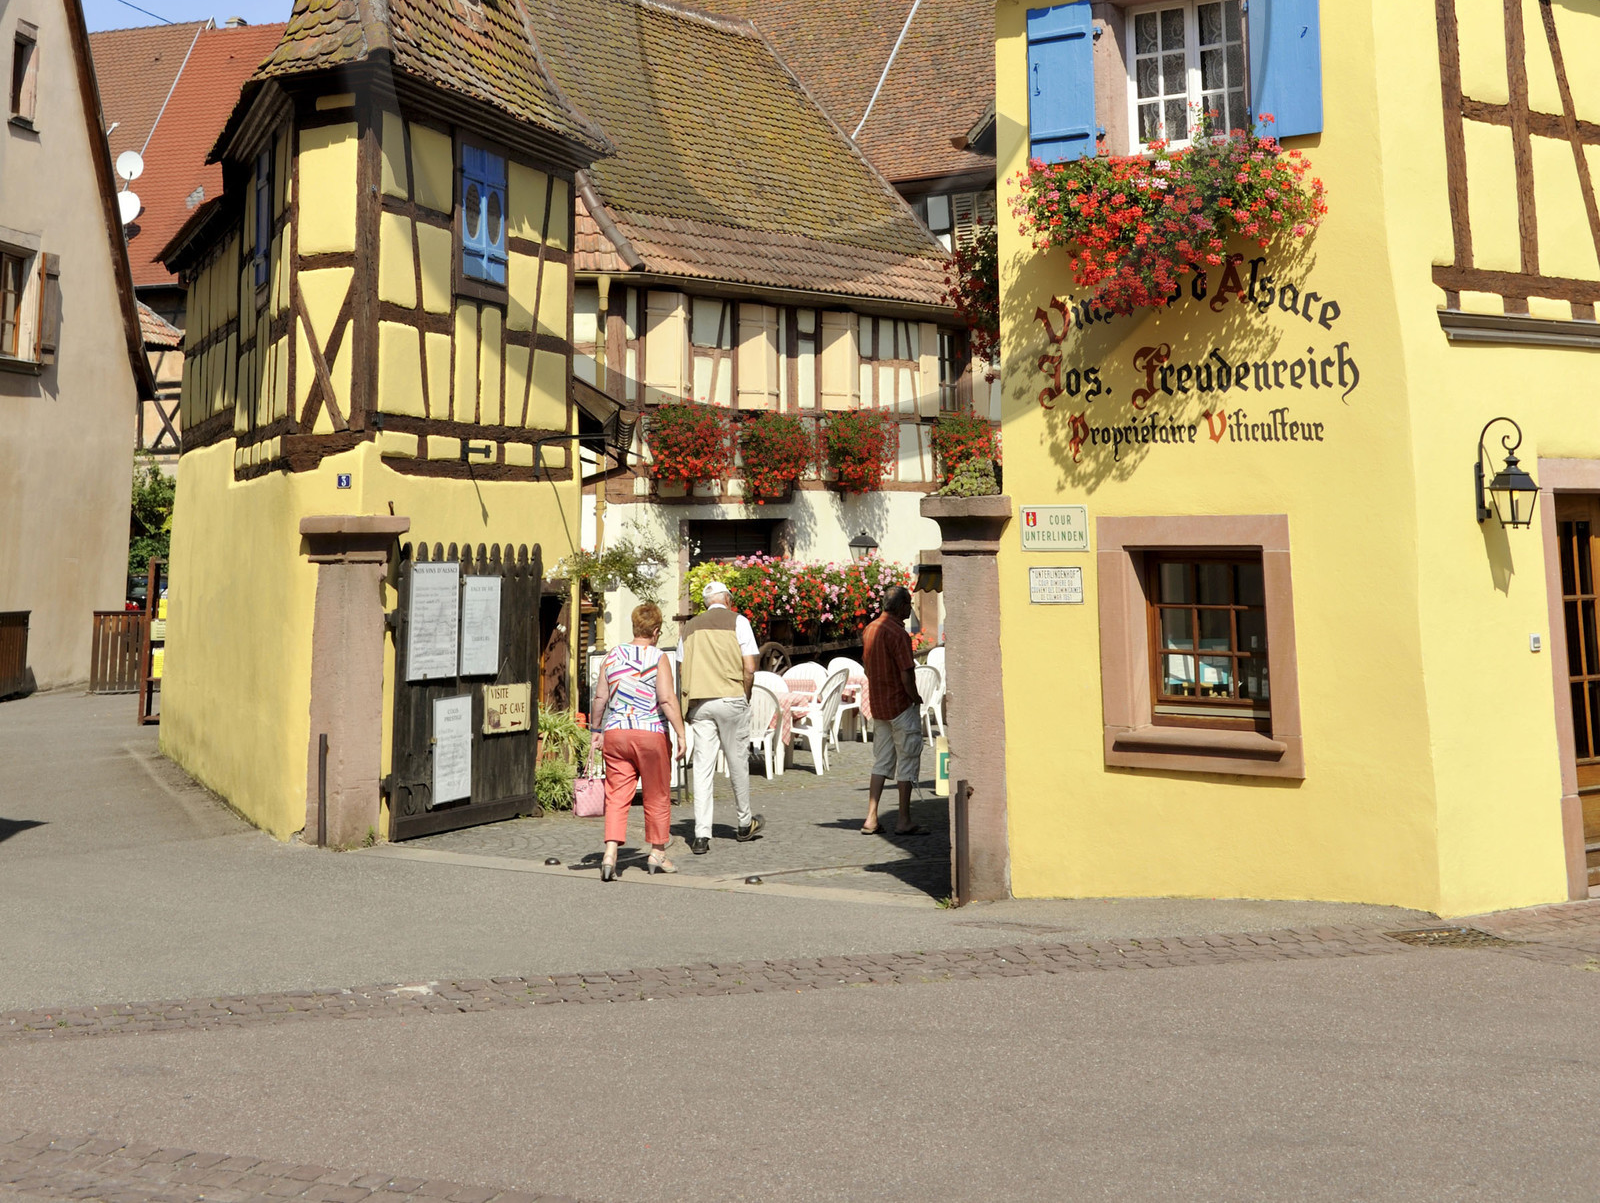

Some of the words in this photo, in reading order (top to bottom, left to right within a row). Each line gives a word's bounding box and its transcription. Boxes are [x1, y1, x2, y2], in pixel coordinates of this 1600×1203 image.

[1187, 253, 1341, 331] dAlsace
[1131, 341, 1360, 410] Freudenreich
[1068, 410, 1197, 463] Propriétaire
[1202, 406, 1325, 444] Viticulteur
[341, 475, 347, 487] 3
[1049, 514, 1072, 526] COUR
[1025, 530, 1084, 542] UNTERLINDEN
[490, 687, 509, 699] VISITE
[500, 703, 507, 715] DE
[510, 702, 525, 714] CAVE
